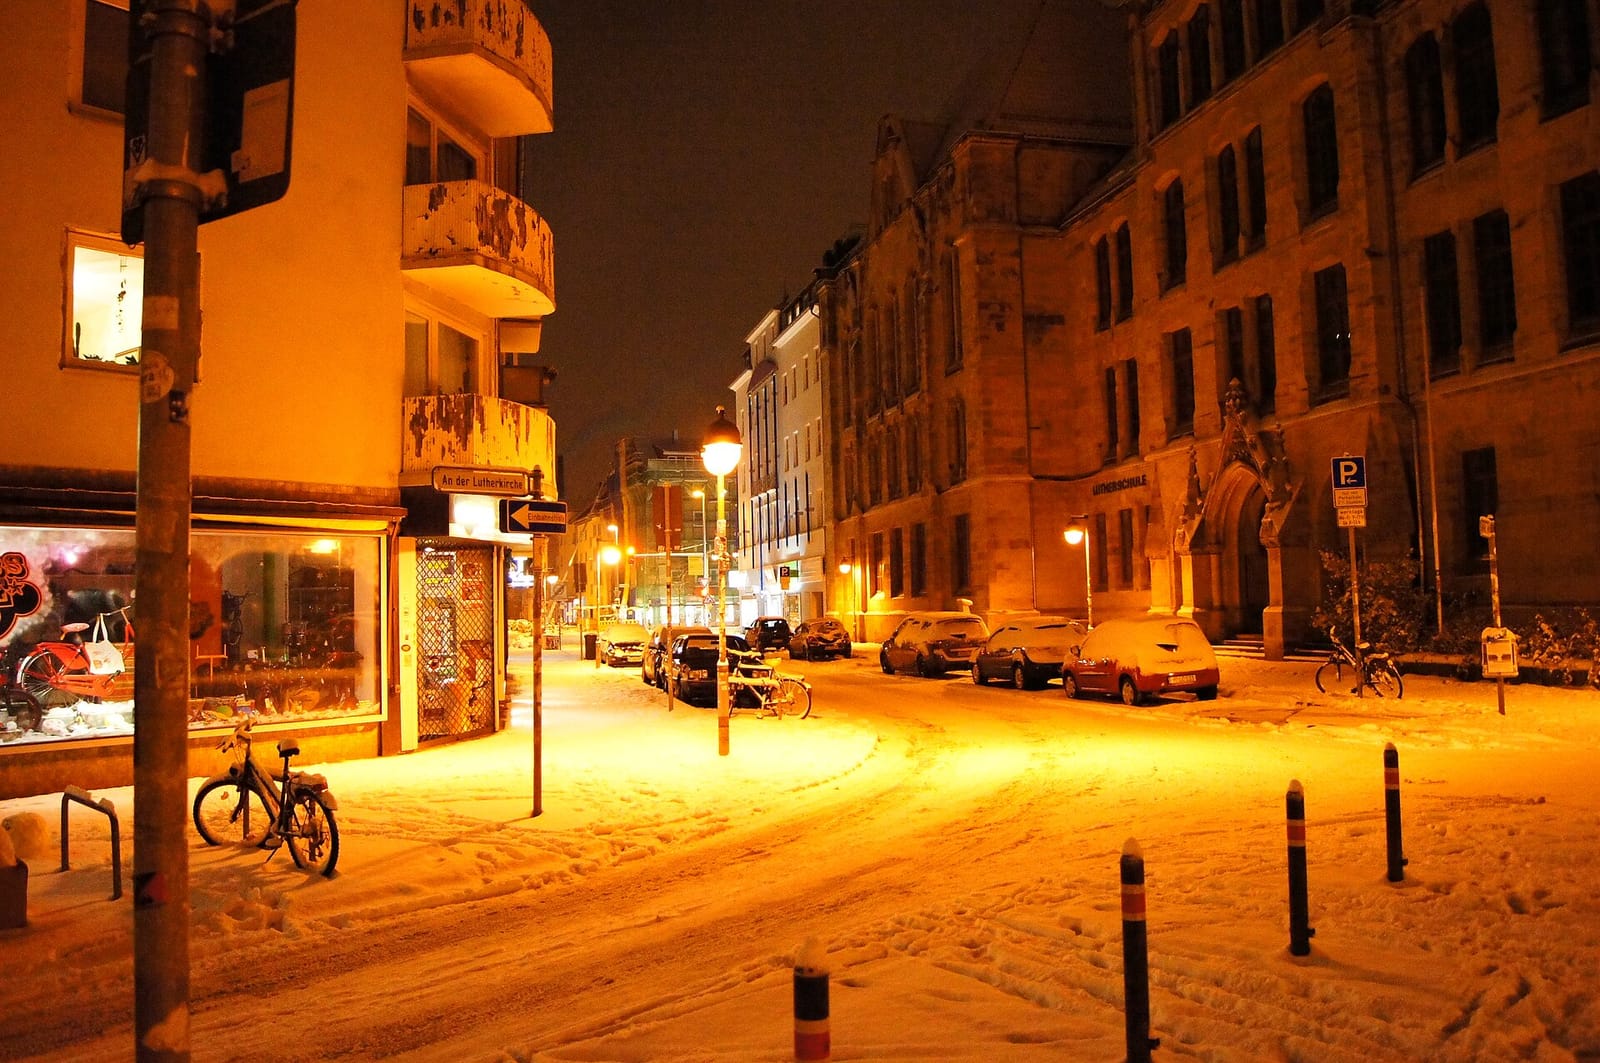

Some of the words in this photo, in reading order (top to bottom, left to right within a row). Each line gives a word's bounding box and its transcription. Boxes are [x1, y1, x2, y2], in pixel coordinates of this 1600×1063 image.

[1340, 461, 1358, 485] P
[442, 474, 452, 486] An
[456, 475, 470, 487] der
[473, 477, 523, 490] Lutherkirche
[781, 567, 788, 576] P
